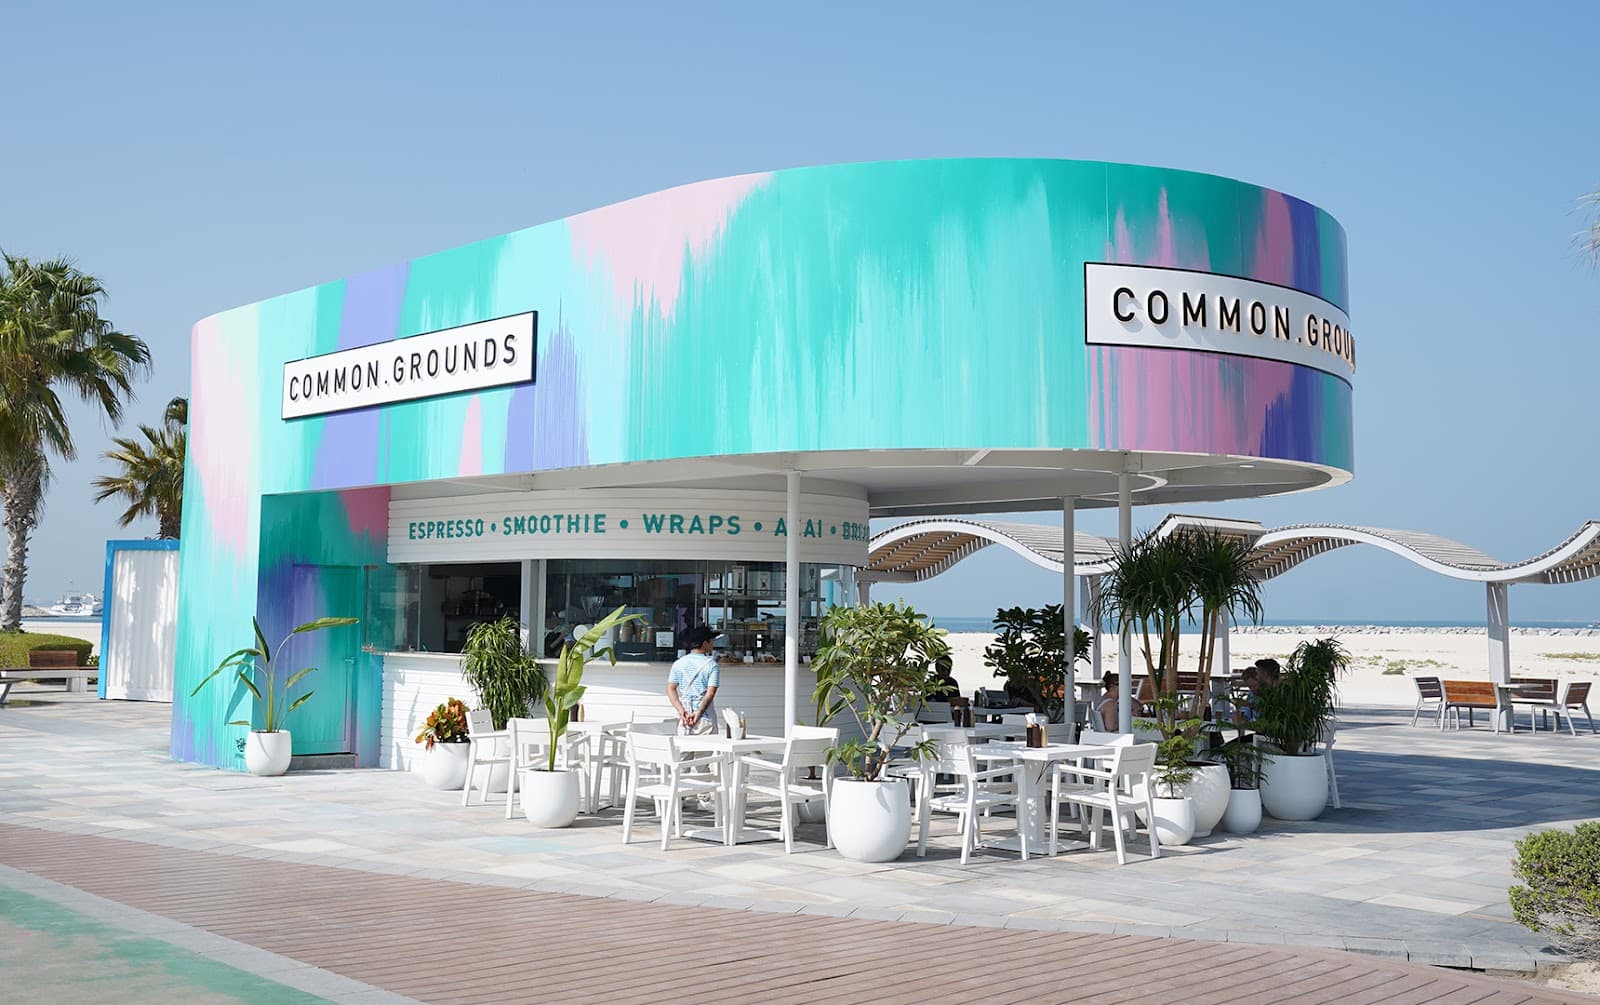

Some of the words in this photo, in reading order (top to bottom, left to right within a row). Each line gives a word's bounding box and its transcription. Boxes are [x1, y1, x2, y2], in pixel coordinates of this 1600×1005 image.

[1112, 287, 1356, 374] COMMON.GROU
[289, 334, 517, 402] COMMON.GROUNDS
[408, 518, 485, 540] ESPRESSO
[503, 513, 607, 536] SMOOTHIE
[642, 513, 741, 535] WRAPS
[774, 517, 823, 538] AAI
